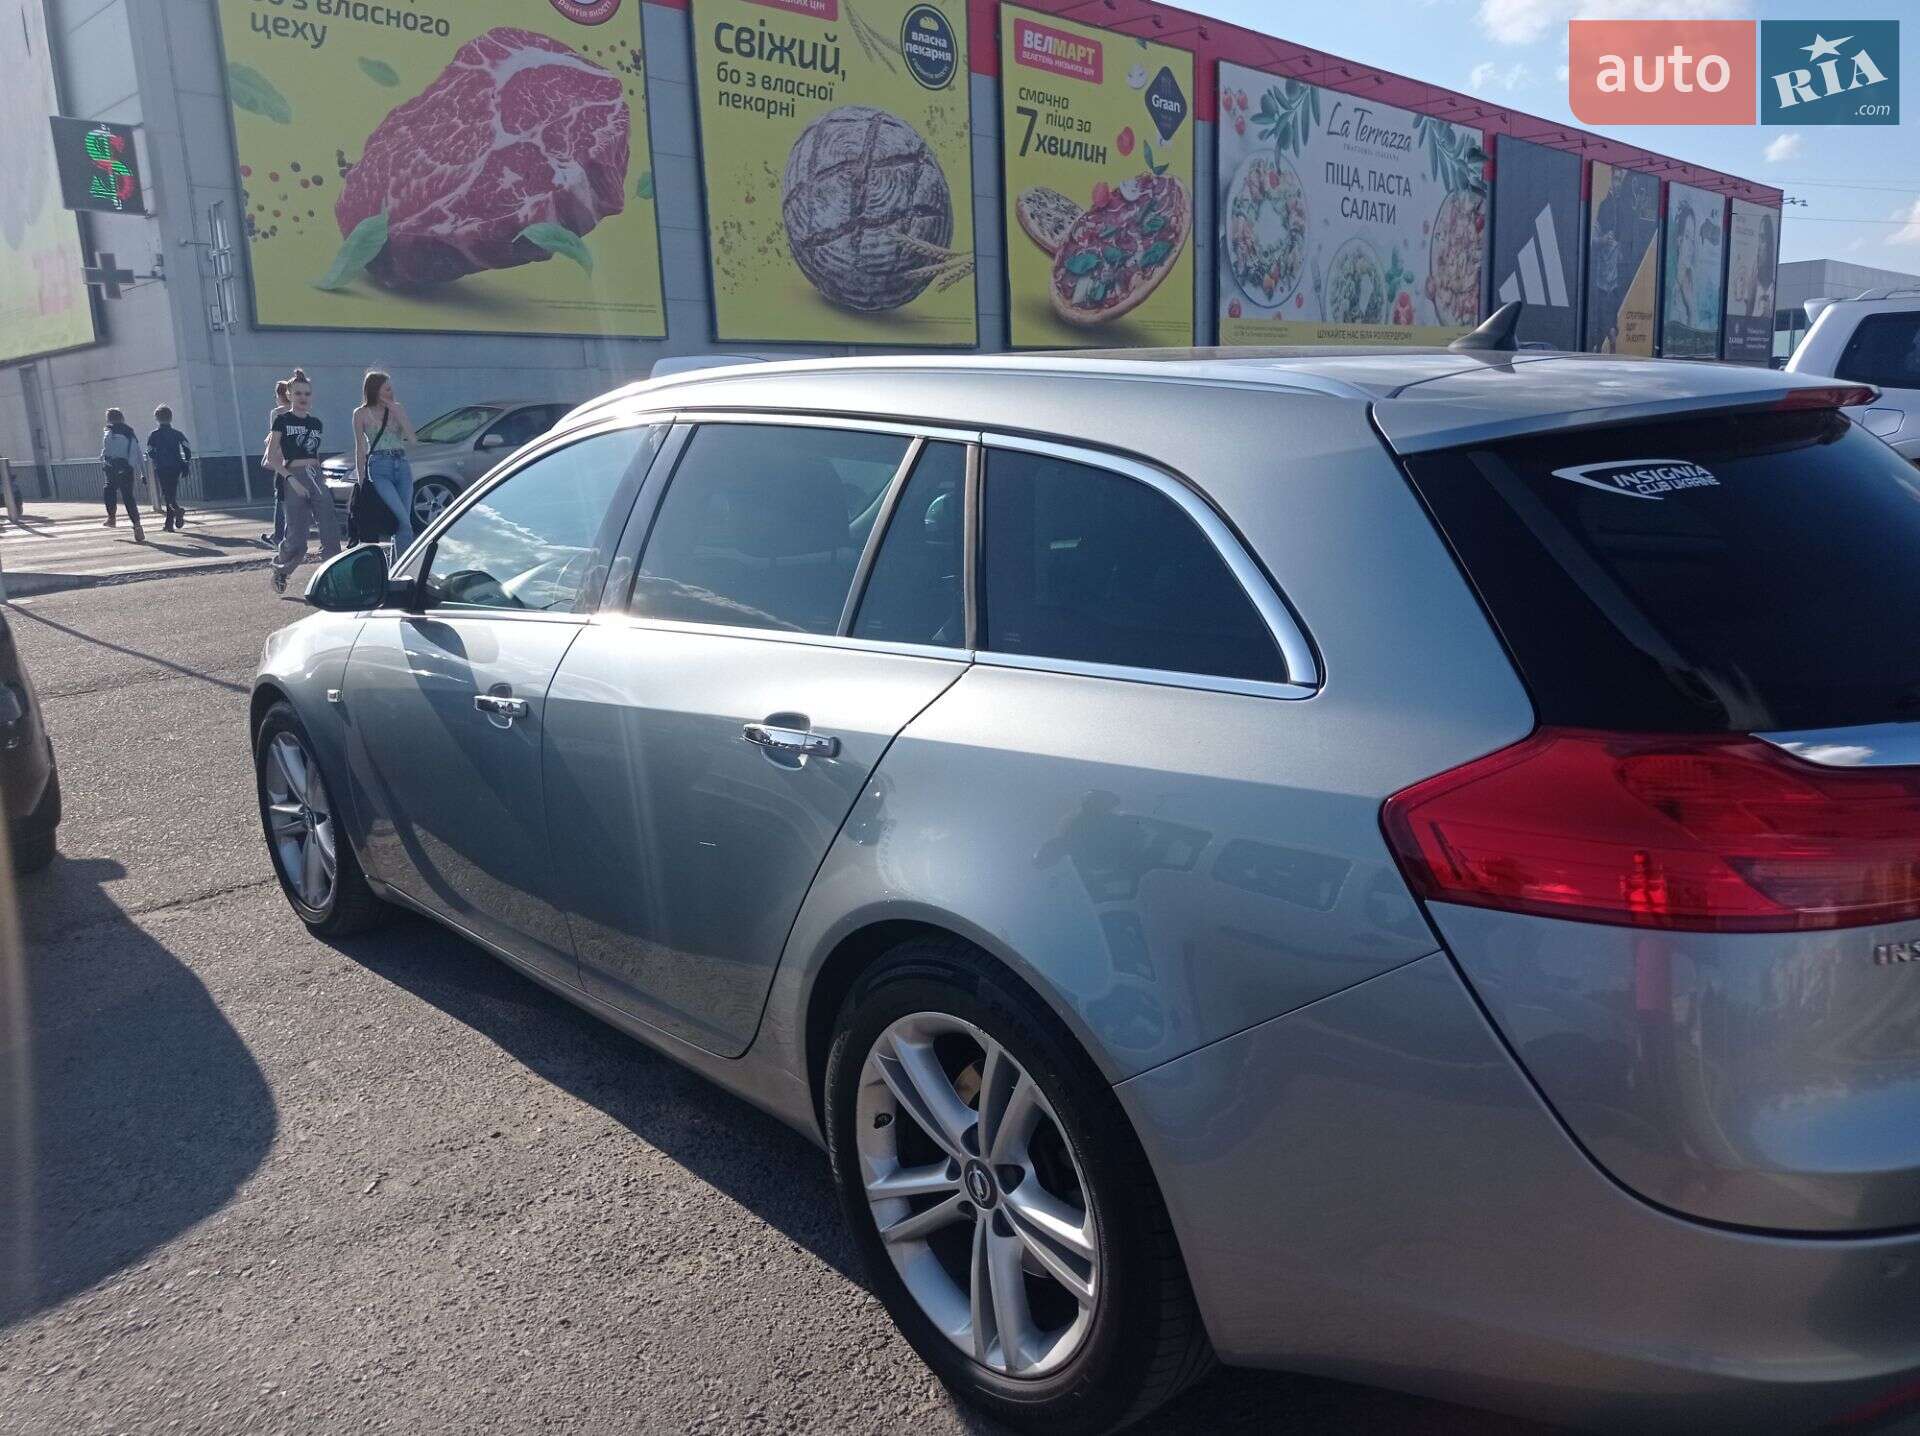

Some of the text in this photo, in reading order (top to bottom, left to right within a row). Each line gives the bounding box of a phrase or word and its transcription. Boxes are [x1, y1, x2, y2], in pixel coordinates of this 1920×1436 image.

[251, 12, 327, 49] цеху
[317, 0, 450, 37] власного
[714, 19, 846, 82] свіжий,
[905, 43, 952, 62] пекарня
[911, 32, 948, 49] власна
[1023, 30, 1095, 65] ВЕЛМАРТ
[717, 61, 835, 103] бо з власної
[718, 90, 795, 119] пекарні
[1018, 87, 1069, 110] смачно
[1151, 94, 1181, 113] Graan
[1046, 109, 1092, 133] піца за
[1326, 102, 1413, 152] La Terrazza
[1016, 106, 1107, 165] 7 хвилин
[1368, 170, 1412, 197] ПАСТА
[1341, 197, 1396, 225] САЛАТИ
[1612, 465, 1711, 487] INSIGNIA
[1636, 476, 1721, 495] CLUB UKRAINE
